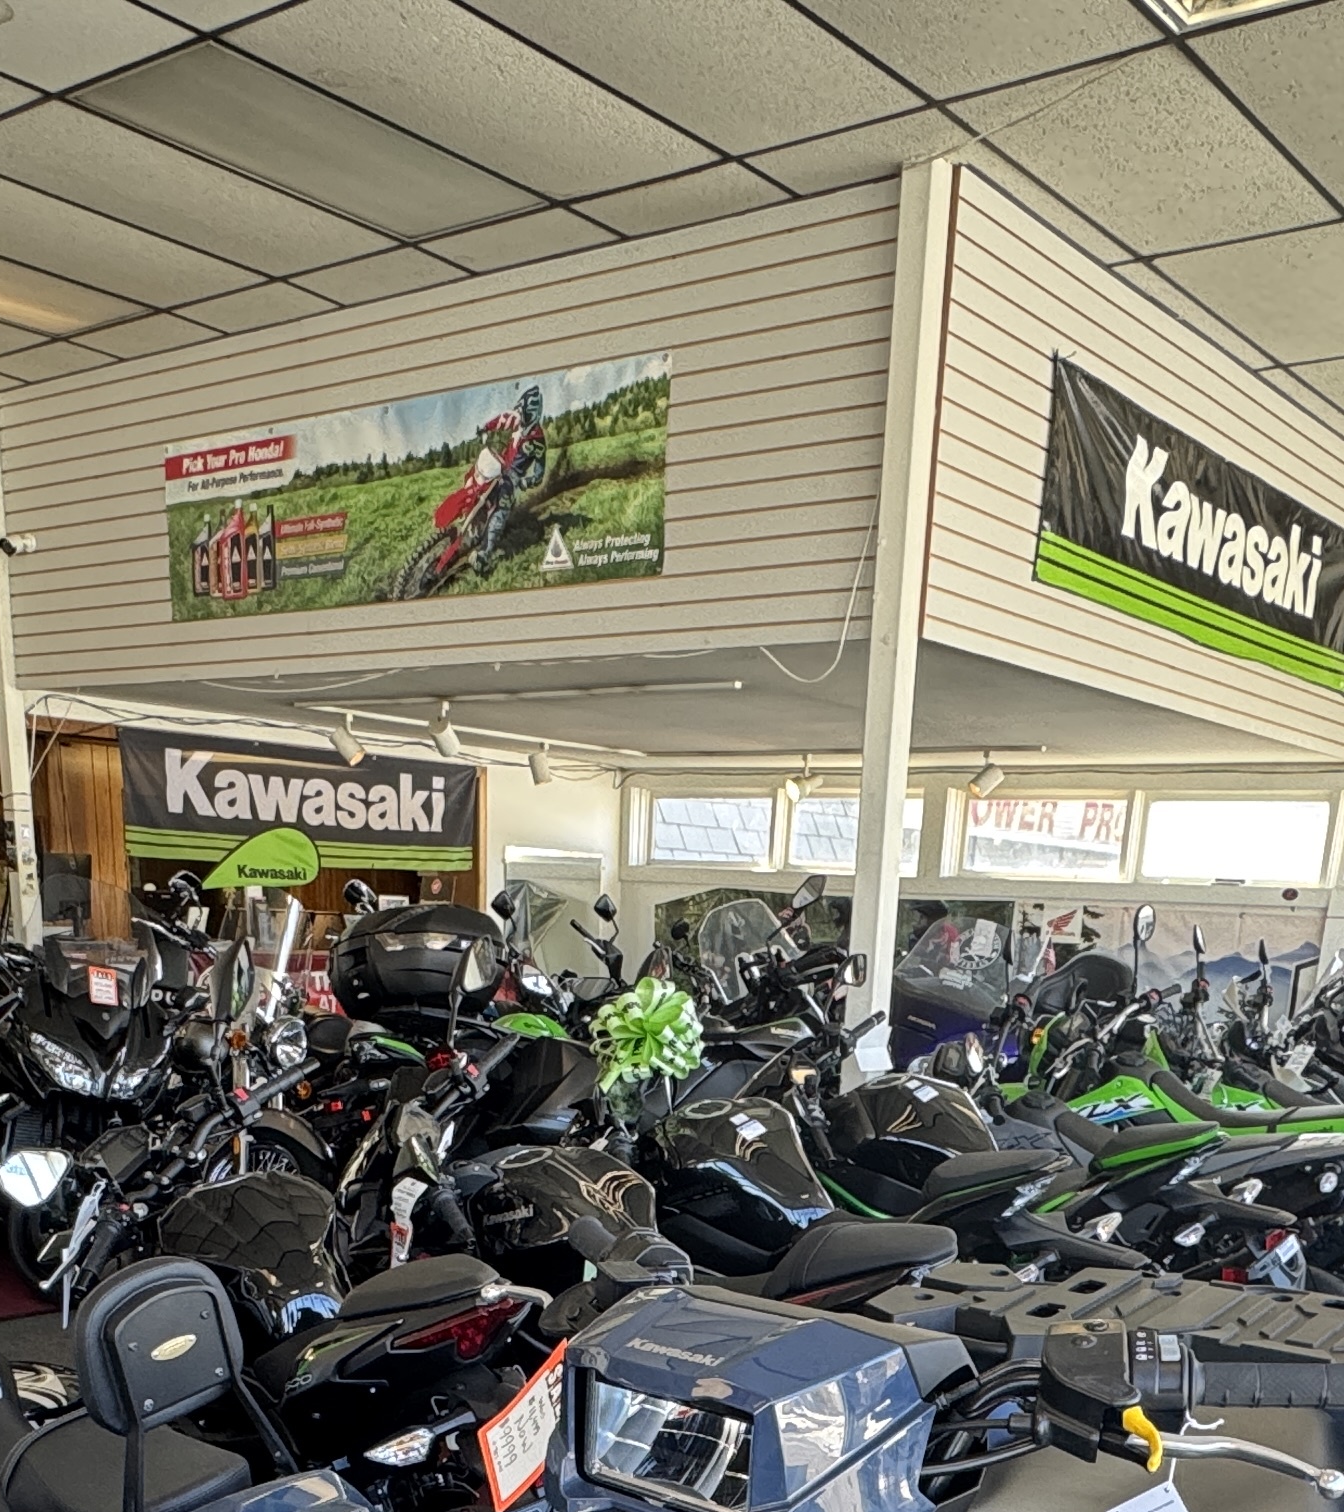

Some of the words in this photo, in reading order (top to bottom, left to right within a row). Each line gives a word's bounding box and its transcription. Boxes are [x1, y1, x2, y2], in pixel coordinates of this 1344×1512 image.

[182, 455, 205, 475] Pick
[206, 453, 227, 470] Your
[228, 449, 246, 467] Pro
[247, 440, 285, 462] Honda!
[187, 481, 200, 492] For
[200, 475, 238, 490] All-Purpose
[1121, 433, 1323, 619] Kawasaki
[573, 539, 604, 552] Always
[605, 533, 651, 548] Protecting
[578, 554, 609, 568] Always
[610, 548, 660, 564] Performing
[164, 748, 446, 833] Kawasaki
[237, 863, 307, 883] Kawasaki
[483, 1203, 534, 1227] Kawasaki
[625, 1337, 726, 1367] Kawasaki
[546, 1362, 565, 1423] SAL
